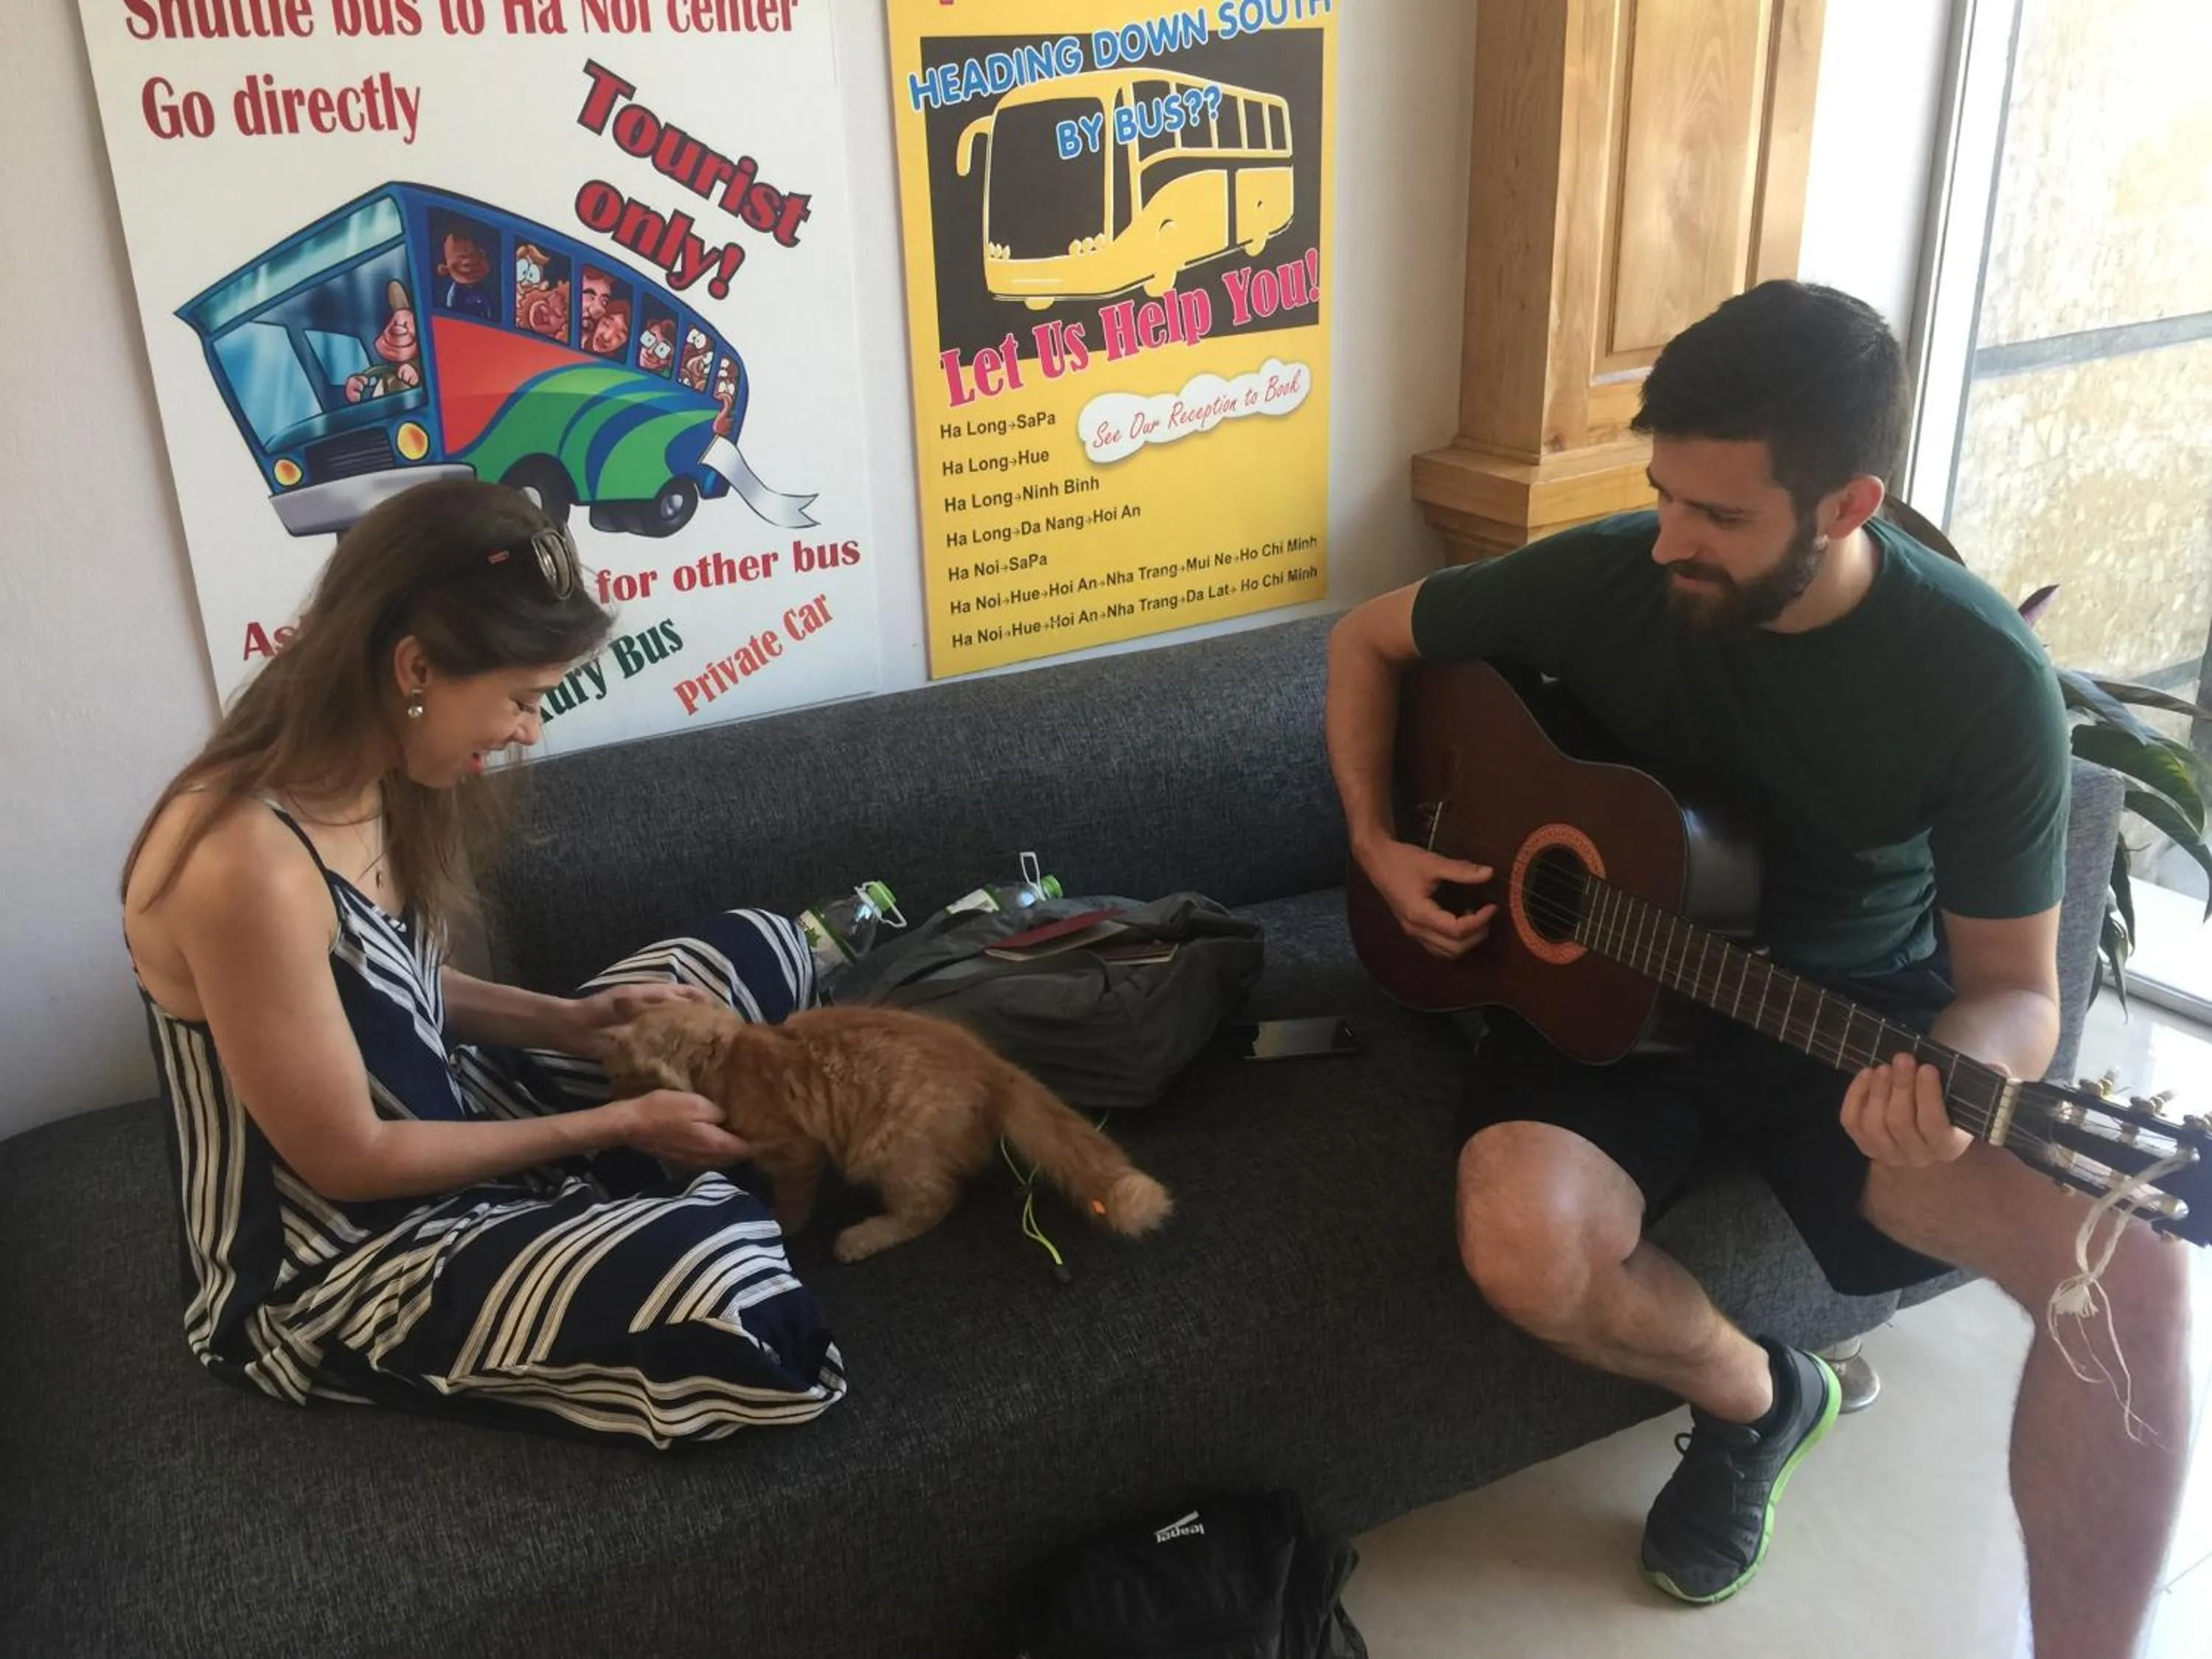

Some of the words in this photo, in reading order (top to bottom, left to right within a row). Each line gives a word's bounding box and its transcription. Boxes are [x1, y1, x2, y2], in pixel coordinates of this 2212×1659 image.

[125, 0, 314, 40] Shuttle
[333, 0, 423, 37] bus
[439, 0, 485, 35] to
[501, 0, 568, 35] Ha
[667, 0, 799, 32] center
[908, 36, 1083, 112] HEADING
[1092, 10, 1208, 69] DOWN
[142, 76, 215, 140] Go
[234, 72, 421, 145] directly
[1055, 111, 1105, 160] BY
[1113, 83, 1223, 145] BUS??
[577, 58, 812, 248] Tourist
[575, 179, 745, 300] only!
[940, 332, 1023, 408] Let
[1033, 319, 1090, 380] Us
[1099, 285, 1212, 362] Help
[1222, 247, 1321, 326] You!
[940, 424, 961, 439] Ha
[967, 420, 1006, 436] Long
[1017, 411, 1056, 429] SaPa
[1093, 421, 1121, 448] See
[1130, 412, 1160, 439] Our
[1167, 396, 1238, 429] Reception
[1244, 389, 1258, 406] to
[1264, 369, 1302, 403] Book
[942, 461, 964, 476] Ha
[969, 456, 1008, 473] Long
[1018, 450, 1050, 465] Hue
[945, 498, 966, 513] Ha
[972, 491, 1013, 509] Long
[1023, 482, 1059, 501] Ninh
[1064, 476, 1099, 494] Binh
[947, 533, 967, 548] Ha
[973, 526, 1012, 544] Long
[1021, 521, 1040, 535] Da
[1046, 516, 1084, 531] Nang
[1093, 507, 1117, 524] Hoi
[1121, 504, 1141, 519] An
[597, 568, 658, 604] for
[672, 552, 779, 592] other
[793, 540, 860, 573] bus
[949, 567, 969, 582] Ha
[975, 560, 999, 577] Noi
[1009, 554, 1048, 571] SaPa
[950, 601, 970, 615] Ha
[976, 594, 1001, 611] Noi
[1011, 588, 1040, 604] Hue
[1049, 579, 1074, 597] Hoi
[1077, 578, 1097, 591] An
[1107, 571, 1134, 586] Nha
[1138, 563, 1178, 580] Trang
[1186, 557, 1210, 572] Mui
[1215, 552, 1232, 567] Ne
[1239, 548, 1258, 562] Ho
[1262, 542, 1284, 557] Chi
[1287, 536, 1318, 552] Minh
[952, 634, 973, 648] Ha
[978, 626, 1003, 644] Noi
[1012, 621, 1041, 637] Hue
[1050, 612, 1074, 630] Hoi
[1078, 610, 1098, 624] An
[1107, 602, 1135, 619] Nha
[1139, 595, 1178, 612] Trang
[1186, 589, 1204, 603] Da
[1208, 583, 1230, 599] Lat
[1241, 578, 1259, 591] Ho
[1262, 572, 1284, 588] Chi
[1288, 566, 1318, 582] Minh
[540, 656, 607, 723] ury
[608, 618, 684, 679] Bus
[673, 630, 783, 716] Private
[782, 594, 833, 641] Car
